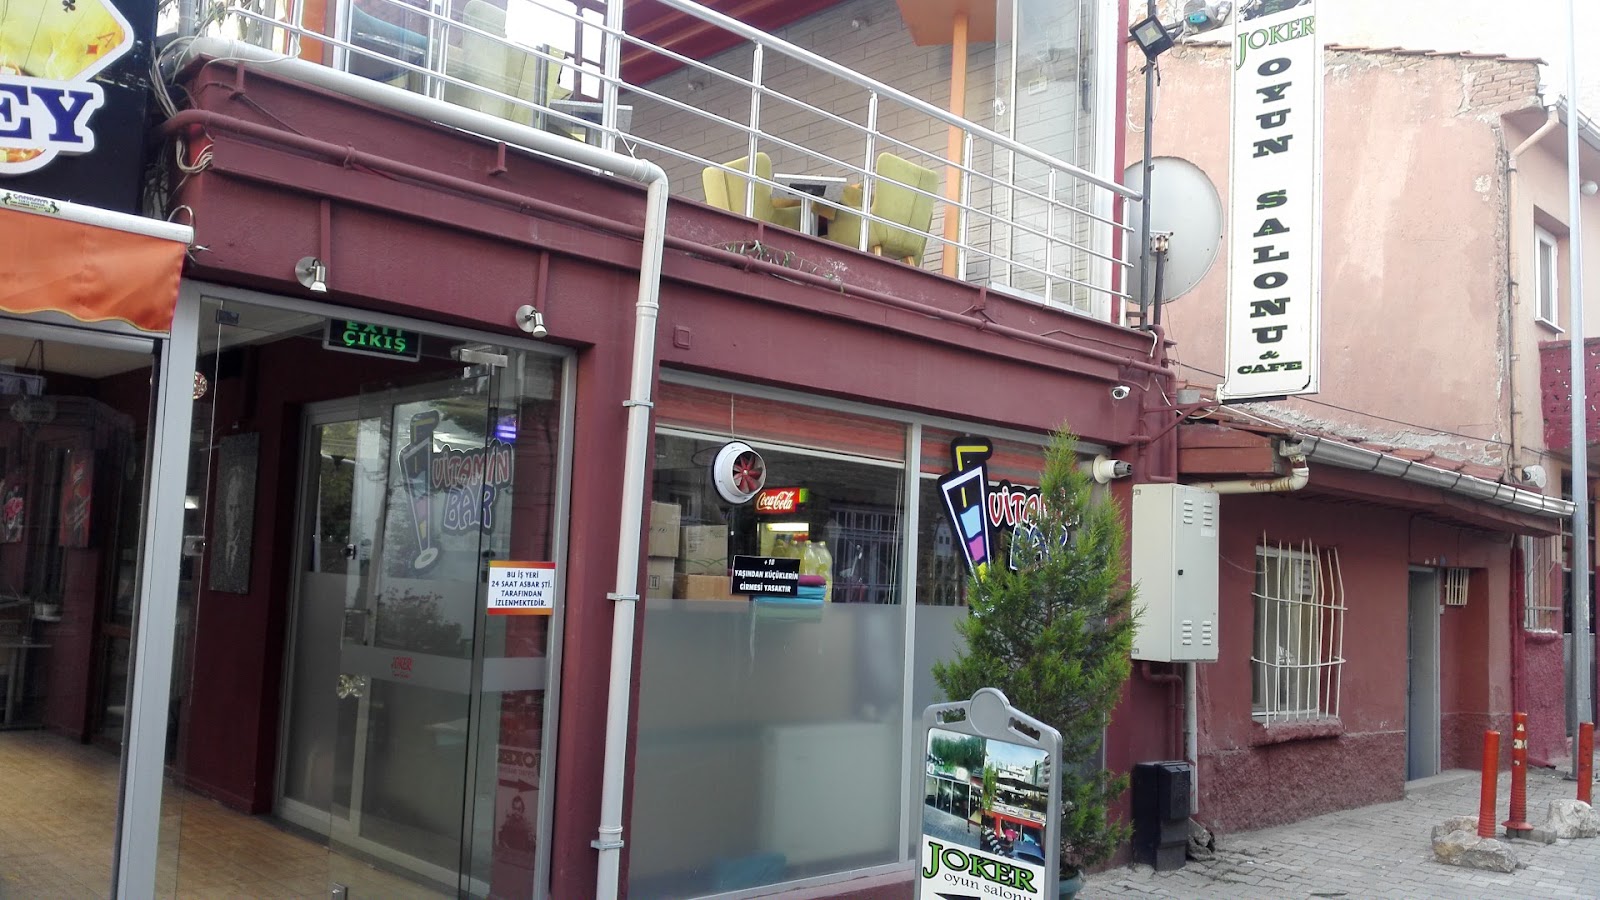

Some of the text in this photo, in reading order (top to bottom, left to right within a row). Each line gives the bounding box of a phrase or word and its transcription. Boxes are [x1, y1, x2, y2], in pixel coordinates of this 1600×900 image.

[1236, 15, 1315, 71] JOKER
[1250, 57, 1293, 344] OYUN SALONU
[342, 330, 406, 353] ÇIKIŞ
[1259, 350, 1280, 360] &
[1237, 361, 1303, 375] CAFE
[444, 484, 498, 531] BAR
[922, 841, 1038, 894] JOKER
[943, 873, 1032, 900] oyun salon
